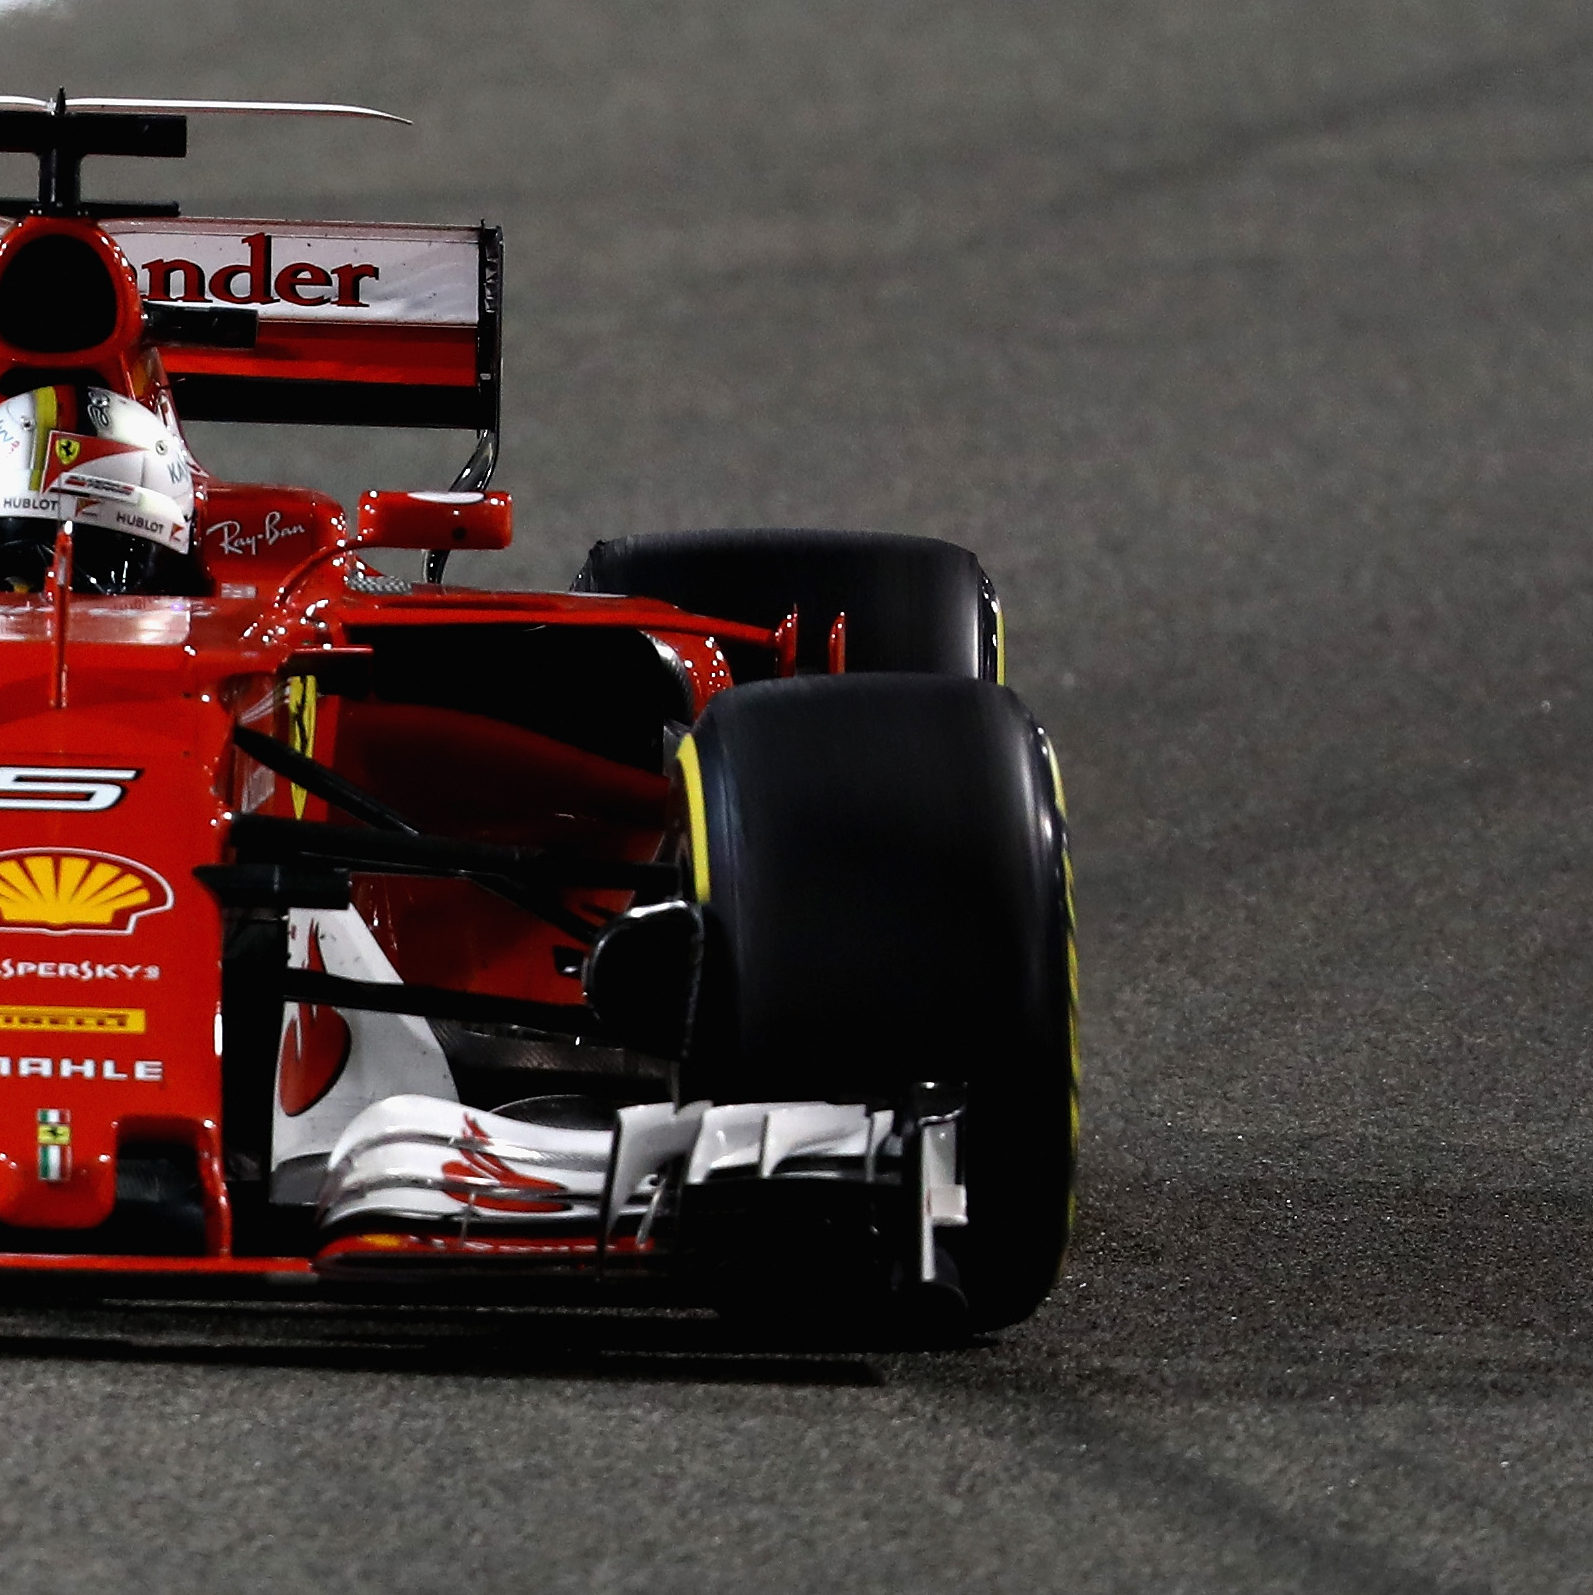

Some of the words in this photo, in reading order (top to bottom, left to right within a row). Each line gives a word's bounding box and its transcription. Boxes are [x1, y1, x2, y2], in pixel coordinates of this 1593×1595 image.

[3, 498, 57, 512] HUBLOT
[116, 511, 164, 534] HUBLOT
[206, 511, 305, 555] Ray-Ban
